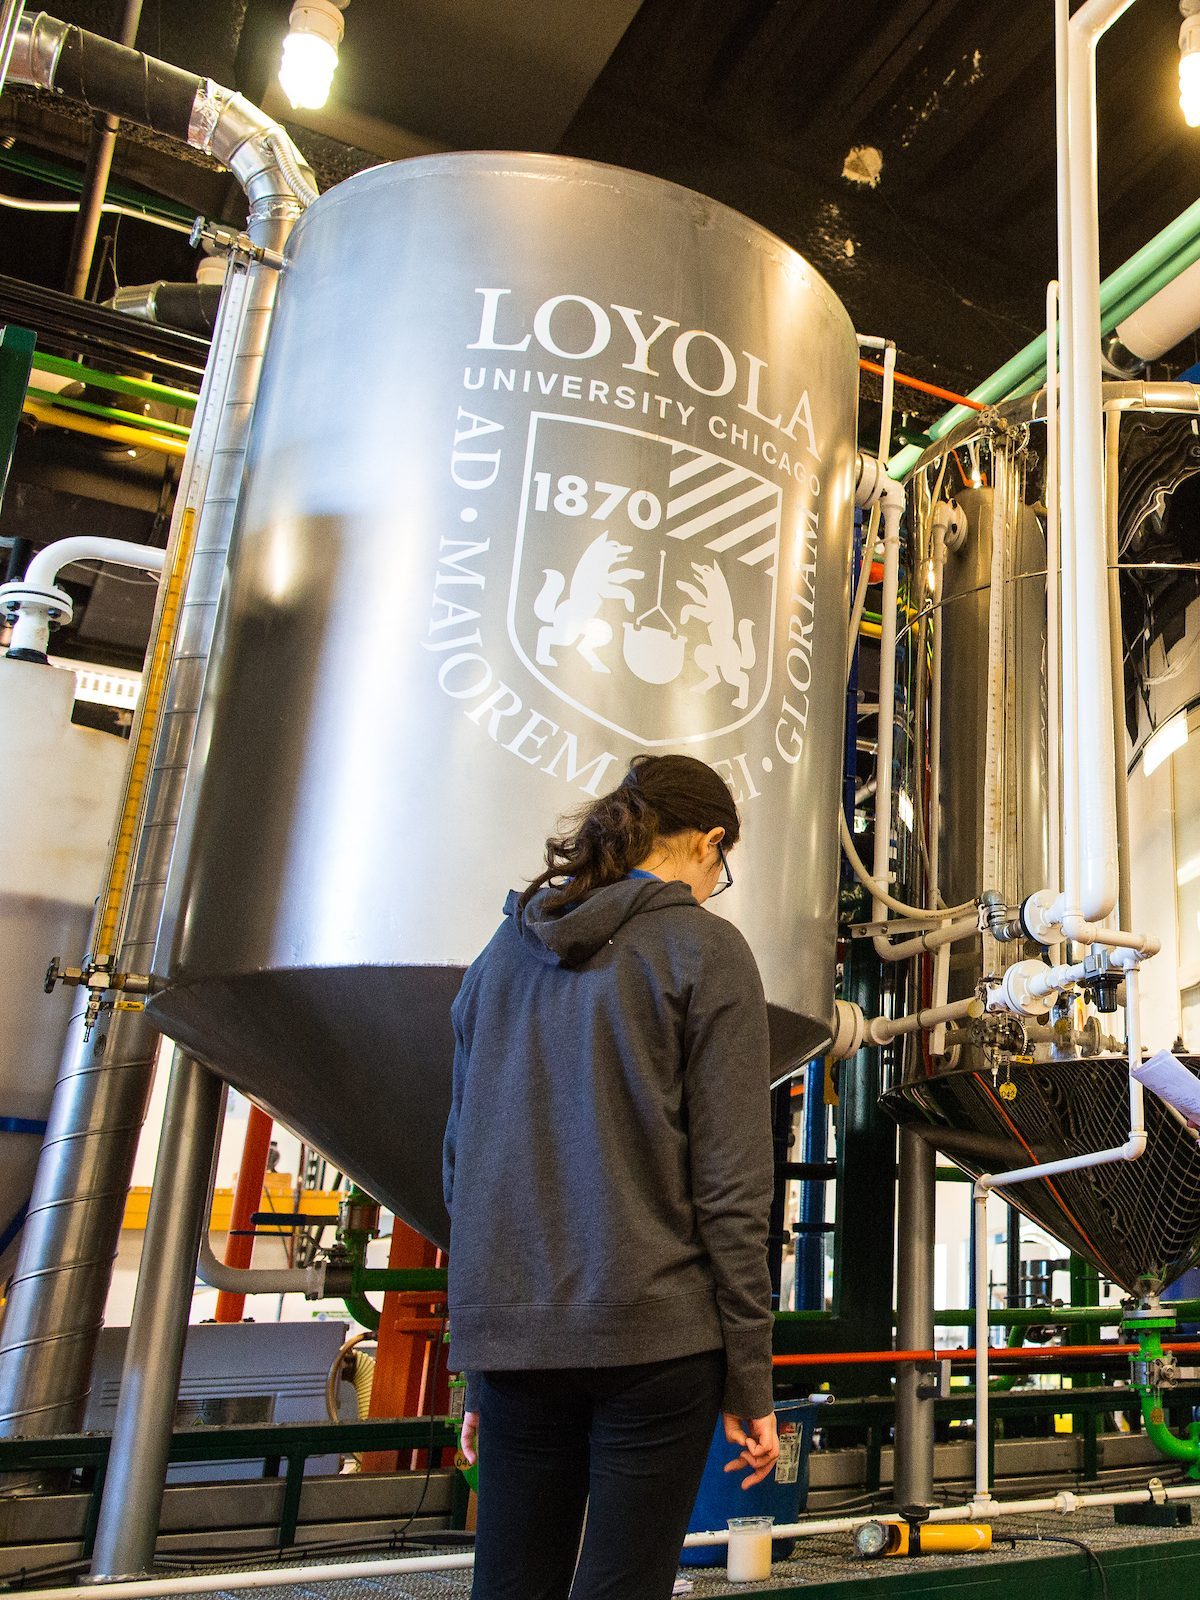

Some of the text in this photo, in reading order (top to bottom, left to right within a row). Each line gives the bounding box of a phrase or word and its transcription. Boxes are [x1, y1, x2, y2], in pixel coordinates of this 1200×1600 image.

[463, 366, 821, 497] UNIVERSITY CHICAGO
[466, 287, 823, 463] LOYOLA
[532, 471, 662, 531] 1870
[420, 404, 820, 804] AD MAJOREM EI GLORIAM
